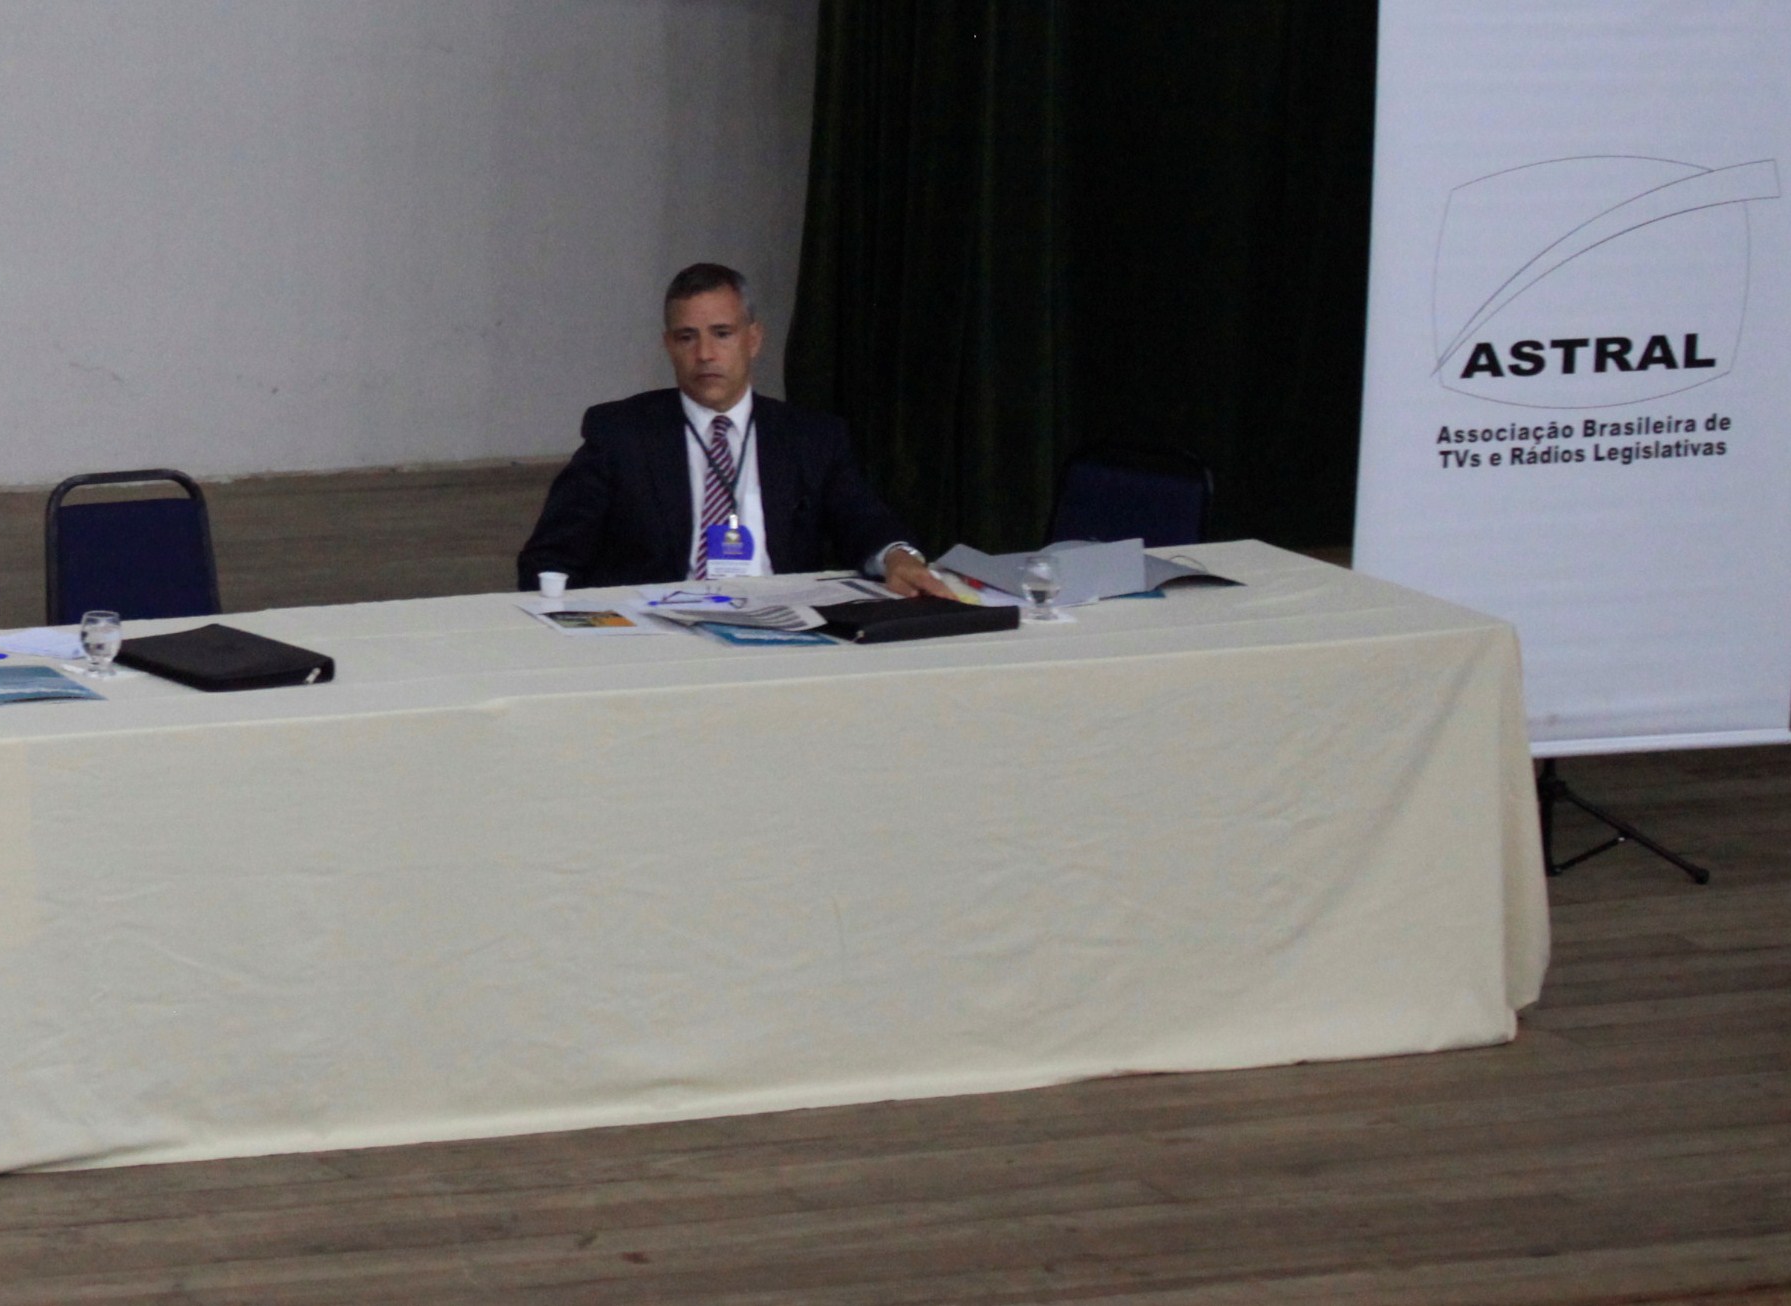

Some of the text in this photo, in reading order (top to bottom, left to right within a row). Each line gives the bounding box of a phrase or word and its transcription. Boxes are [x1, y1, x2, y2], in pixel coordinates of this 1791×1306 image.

[1460, 333, 1717, 379] ASTRAL
[1436, 413, 1732, 444] Associação Brasileira de
[1439, 440, 1727, 469] TVs e Rádios Legislativas
